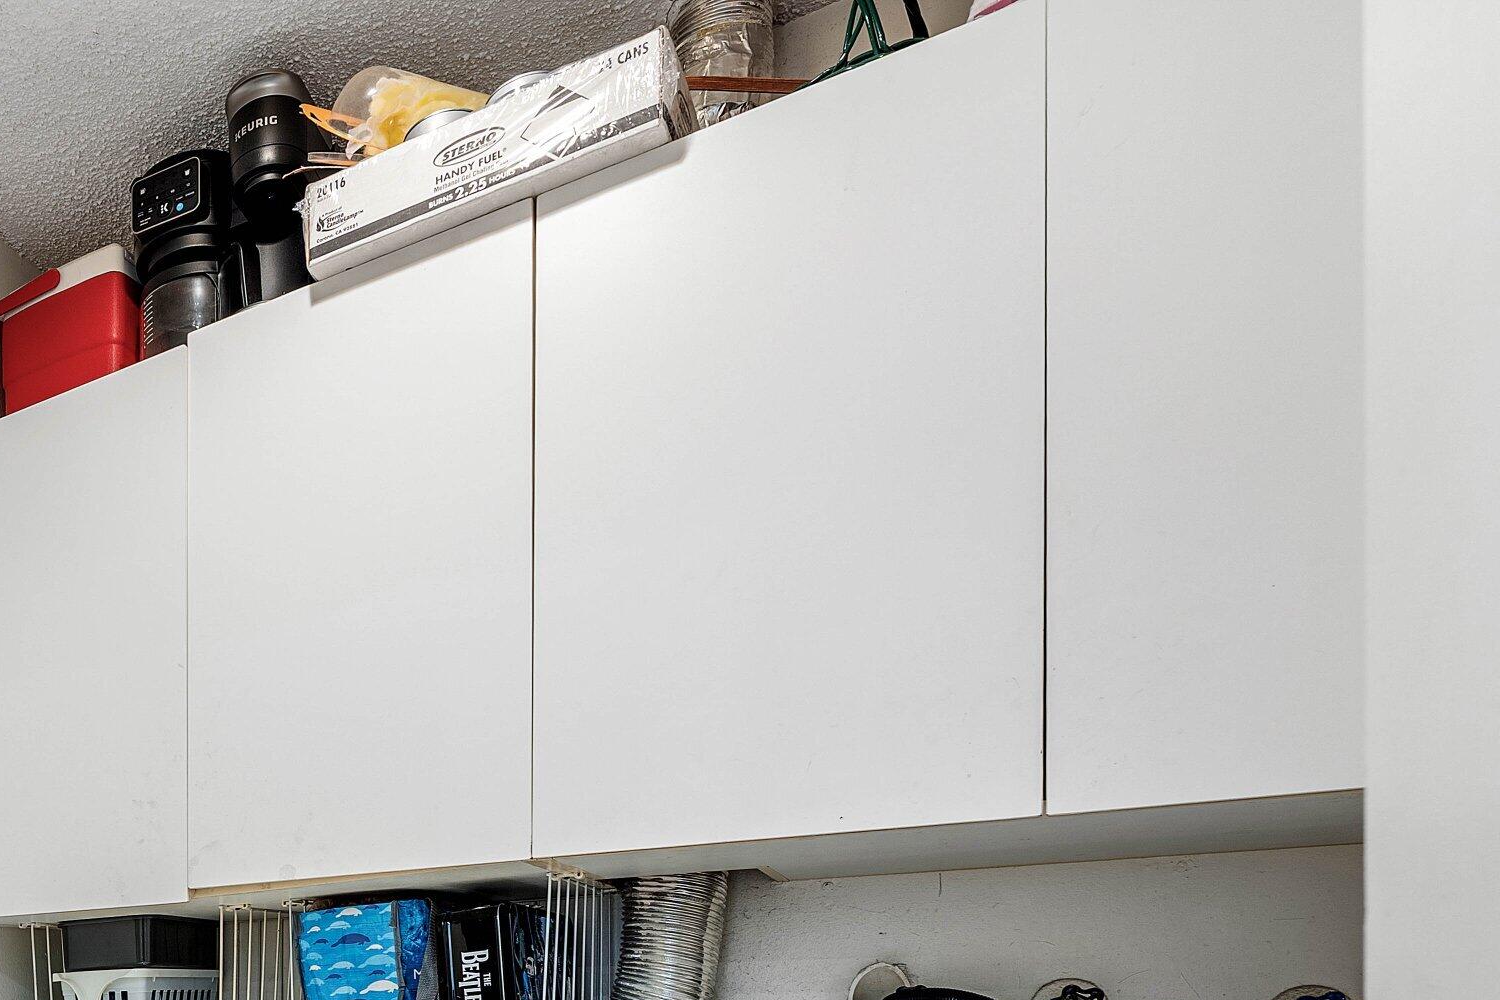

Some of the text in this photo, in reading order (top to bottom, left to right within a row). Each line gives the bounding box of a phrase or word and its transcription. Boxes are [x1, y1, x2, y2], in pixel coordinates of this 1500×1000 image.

[617, 42, 649, 64] CANS
[235, 115, 278, 142] KEURIG
[442, 132, 496, 162] STERNO
[436, 150, 502, 184] HANDY FUEL
[428, 193, 454, 209] BURNS
[454, 178, 487, 200] 2.25
[434, 179, 460, 193] Methanol
[482, 972, 492, 987] THE
